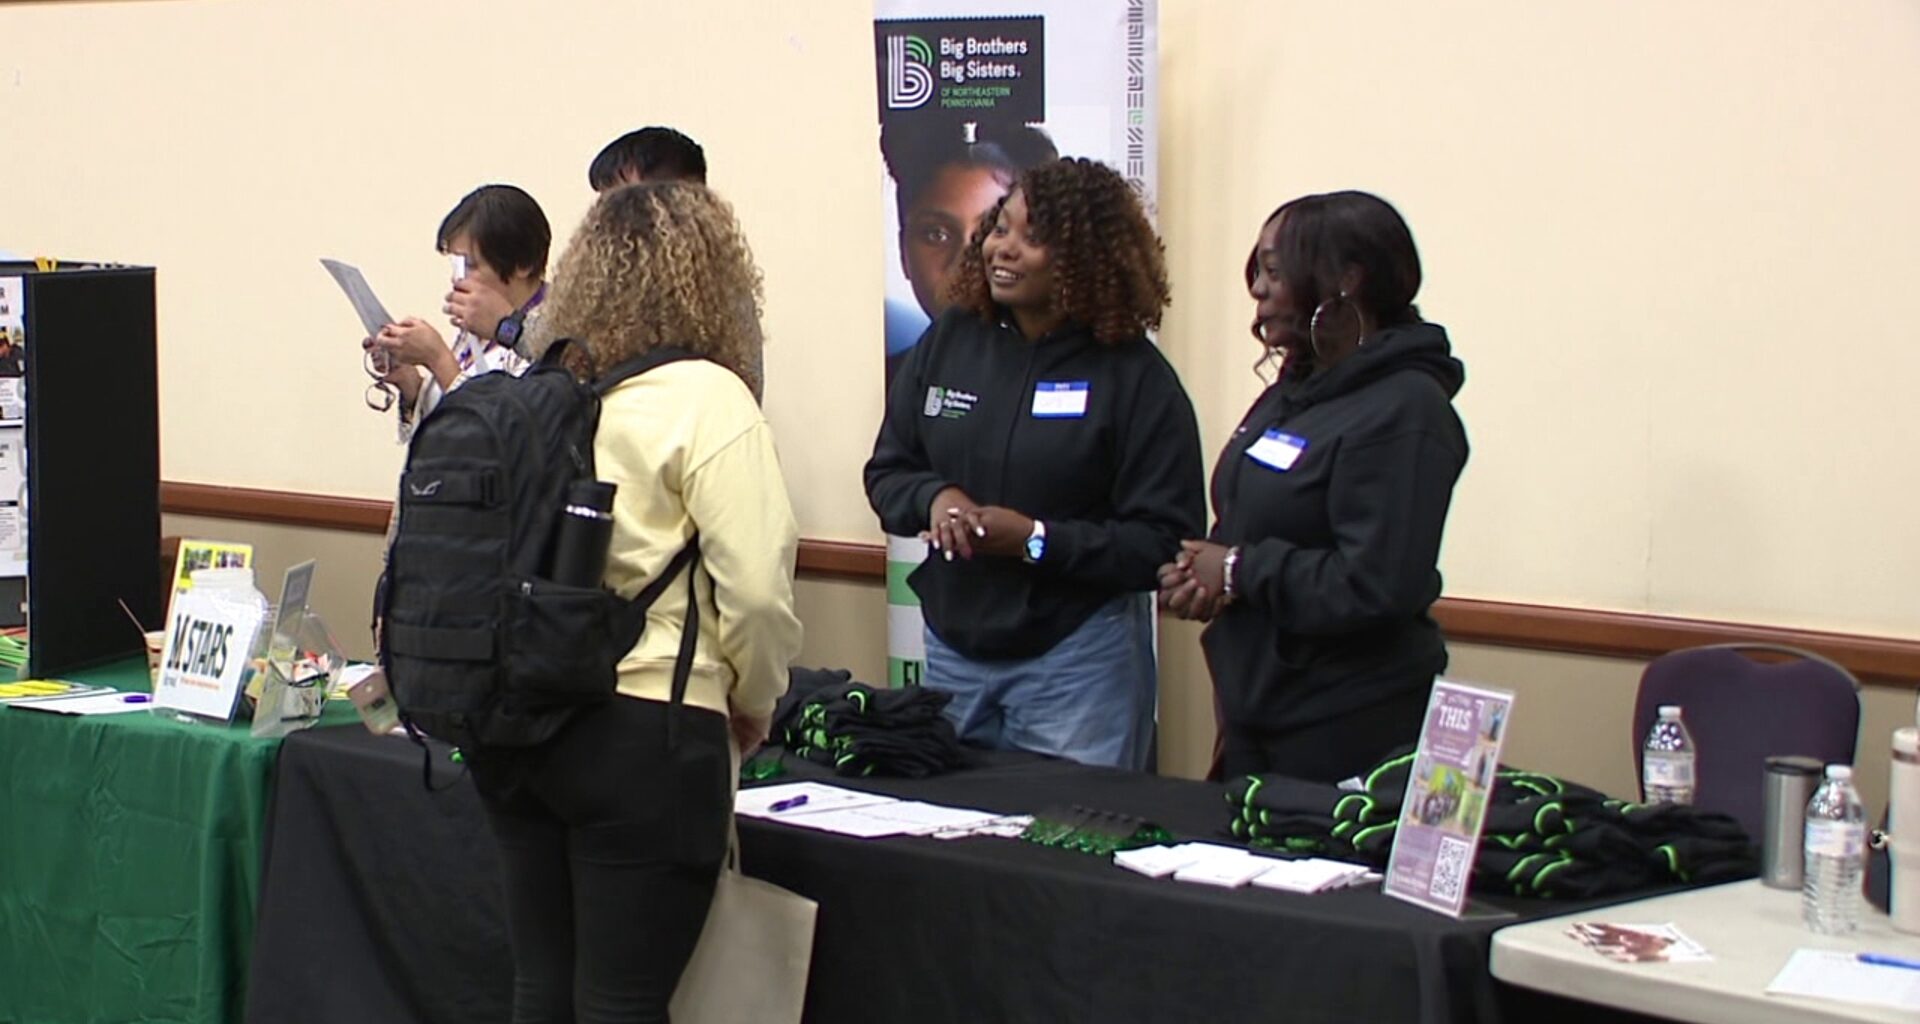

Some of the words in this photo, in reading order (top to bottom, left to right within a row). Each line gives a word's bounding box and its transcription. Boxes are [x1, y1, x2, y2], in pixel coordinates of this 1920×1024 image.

[941, 37, 965, 60] Big
[966, 36, 1028, 55] Brothers
[941, 61, 965, 83] Big
[182, 619, 233, 679] STARS
[1438, 705, 1473, 732] THIS
